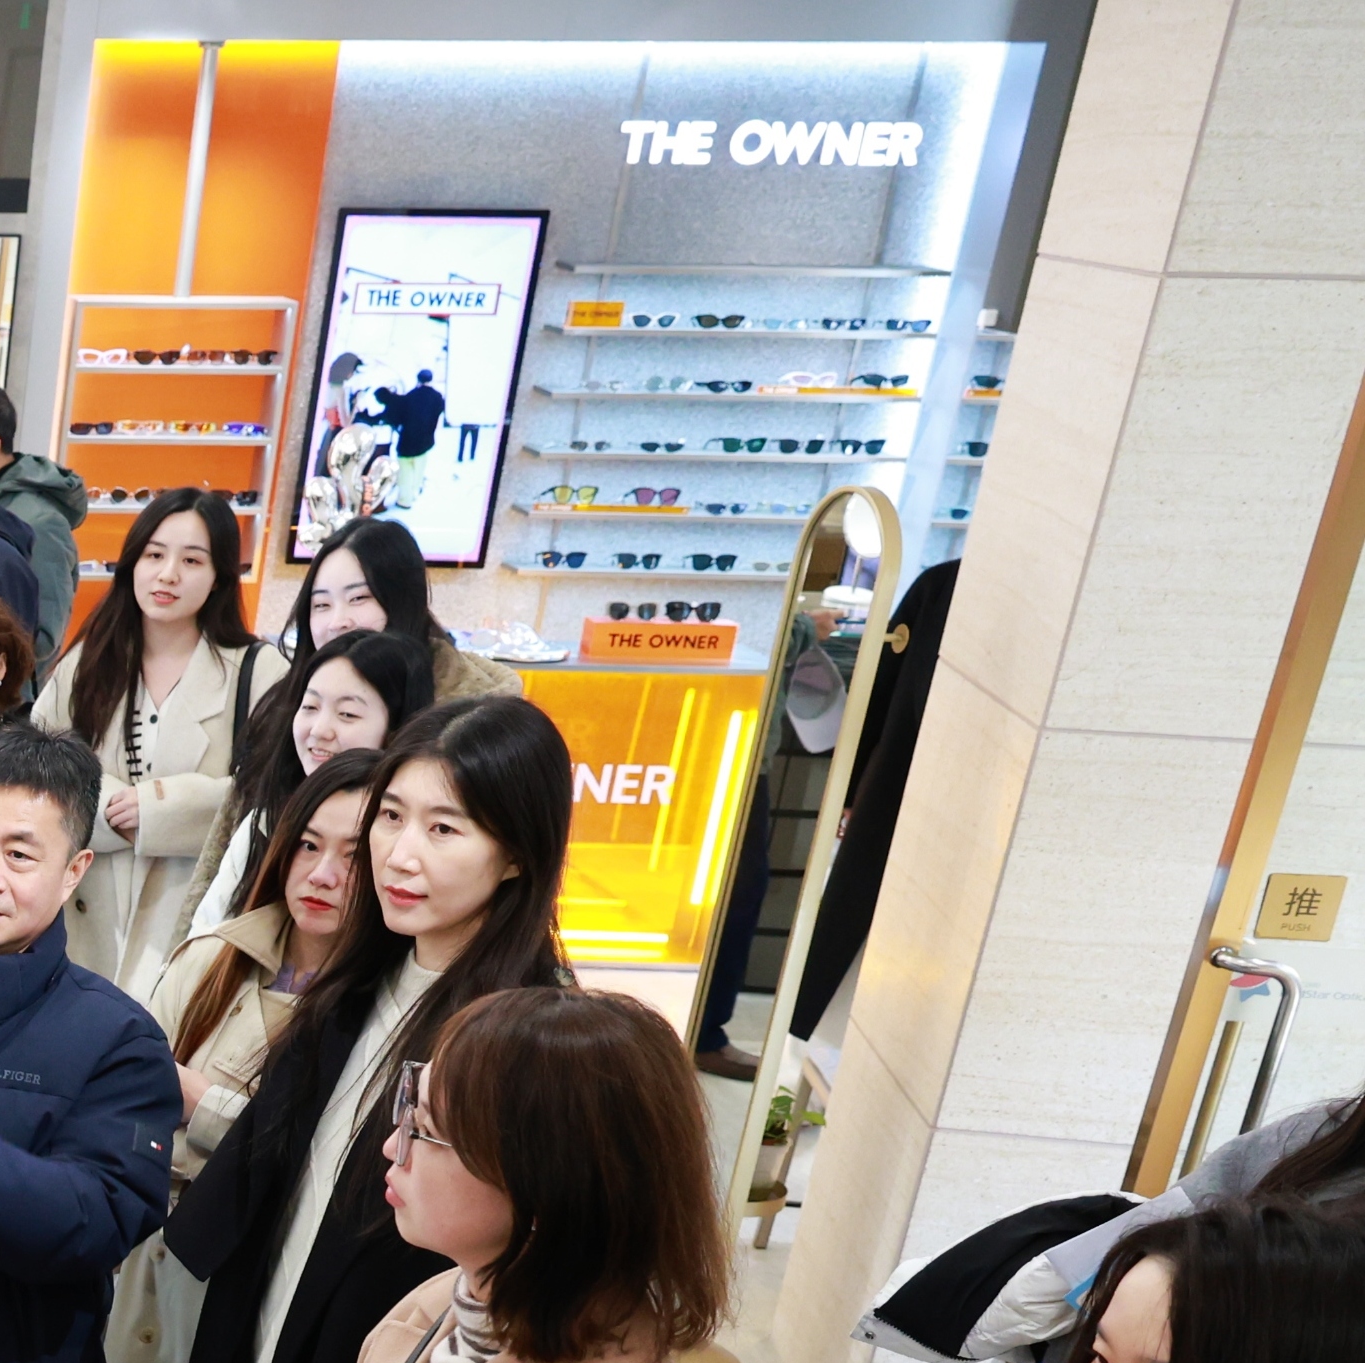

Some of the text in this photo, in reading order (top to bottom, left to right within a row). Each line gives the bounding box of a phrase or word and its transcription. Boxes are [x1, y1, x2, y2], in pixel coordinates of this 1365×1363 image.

[620, 119, 923, 167] THE OWNER
[368, 289, 486, 308] THE OWNER
[608, 633, 719, 649] THE OWNER
[572, 763, 676, 805] NER
[1282, 886, 1323, 917] 推
[1280, 922, 1312, 932] PUSH
